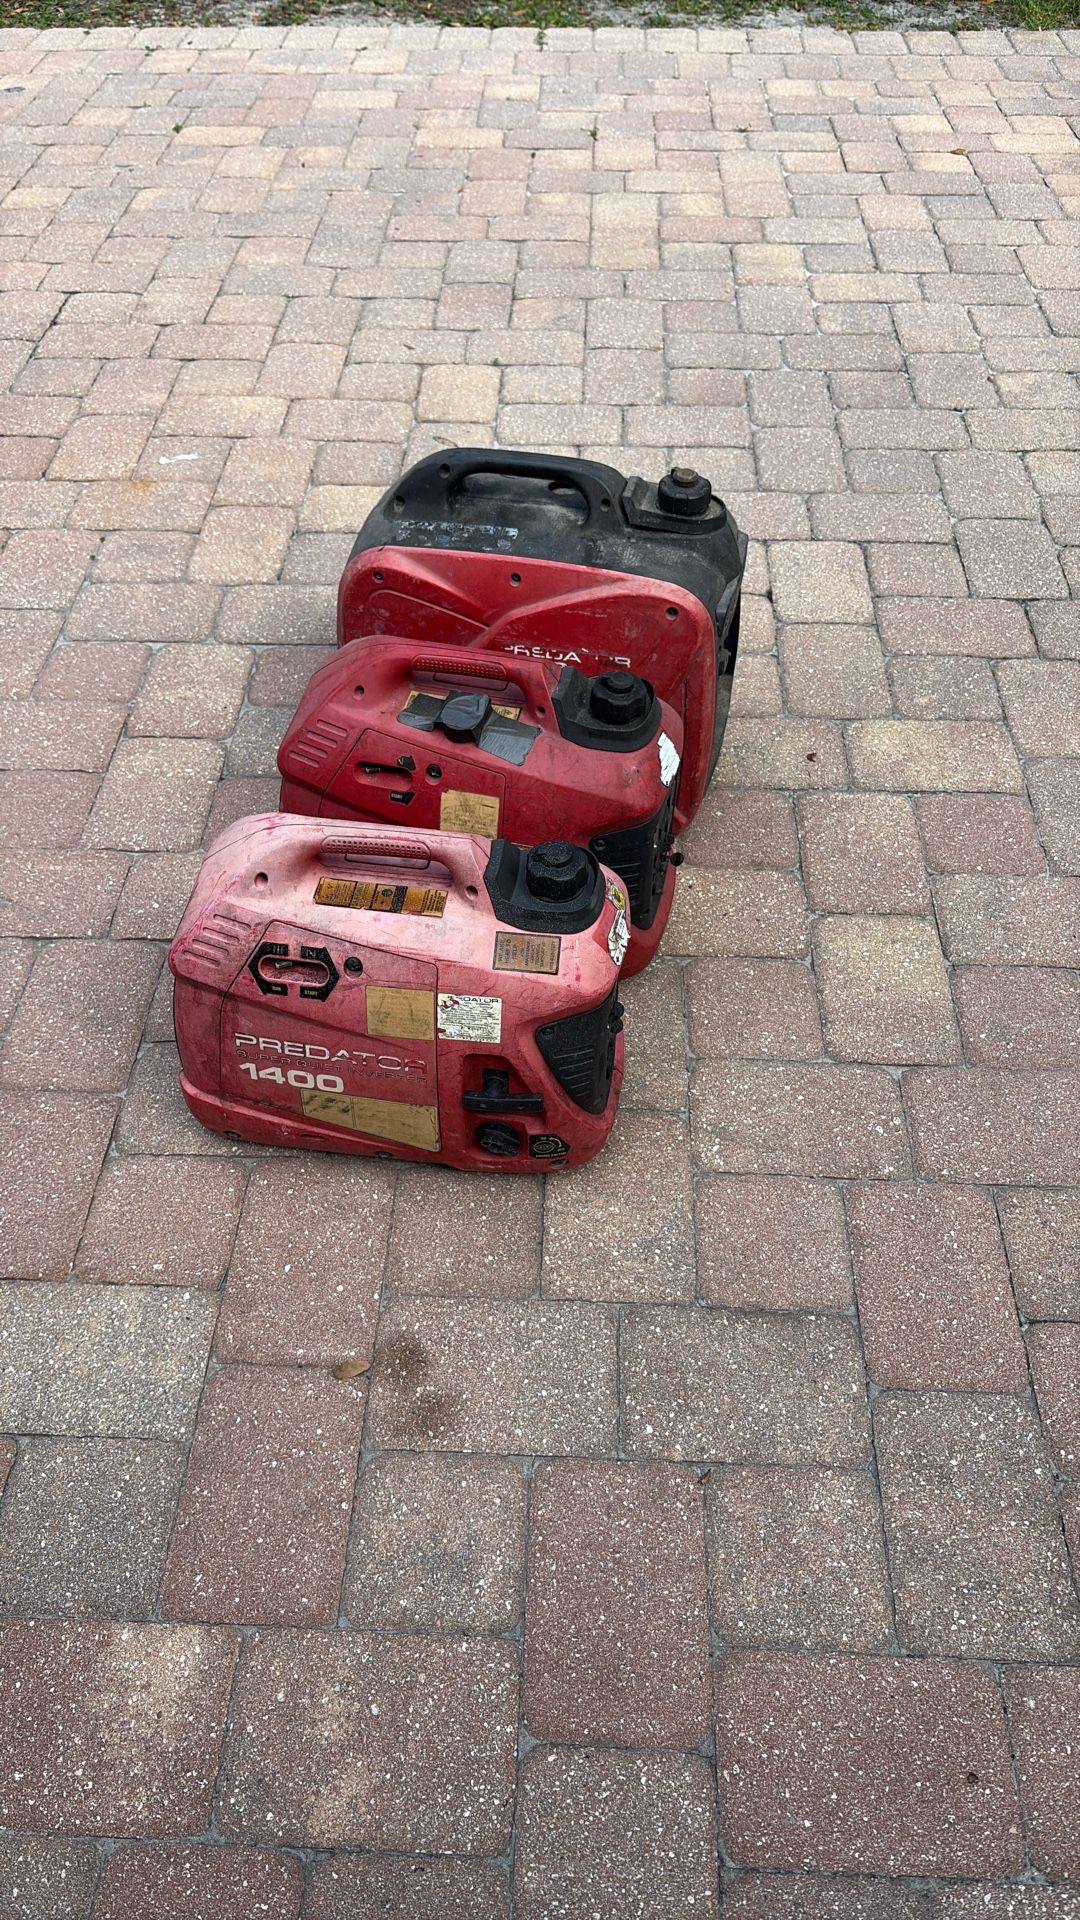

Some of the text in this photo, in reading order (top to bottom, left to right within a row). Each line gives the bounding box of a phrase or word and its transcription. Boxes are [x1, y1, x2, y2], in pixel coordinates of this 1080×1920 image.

[234, 1032, 428, 1075] PREDATOR
[236, 1049, 428, 1085] SUPER QUIET INVERTER
[239, 1062, 345, 1093] 1400
